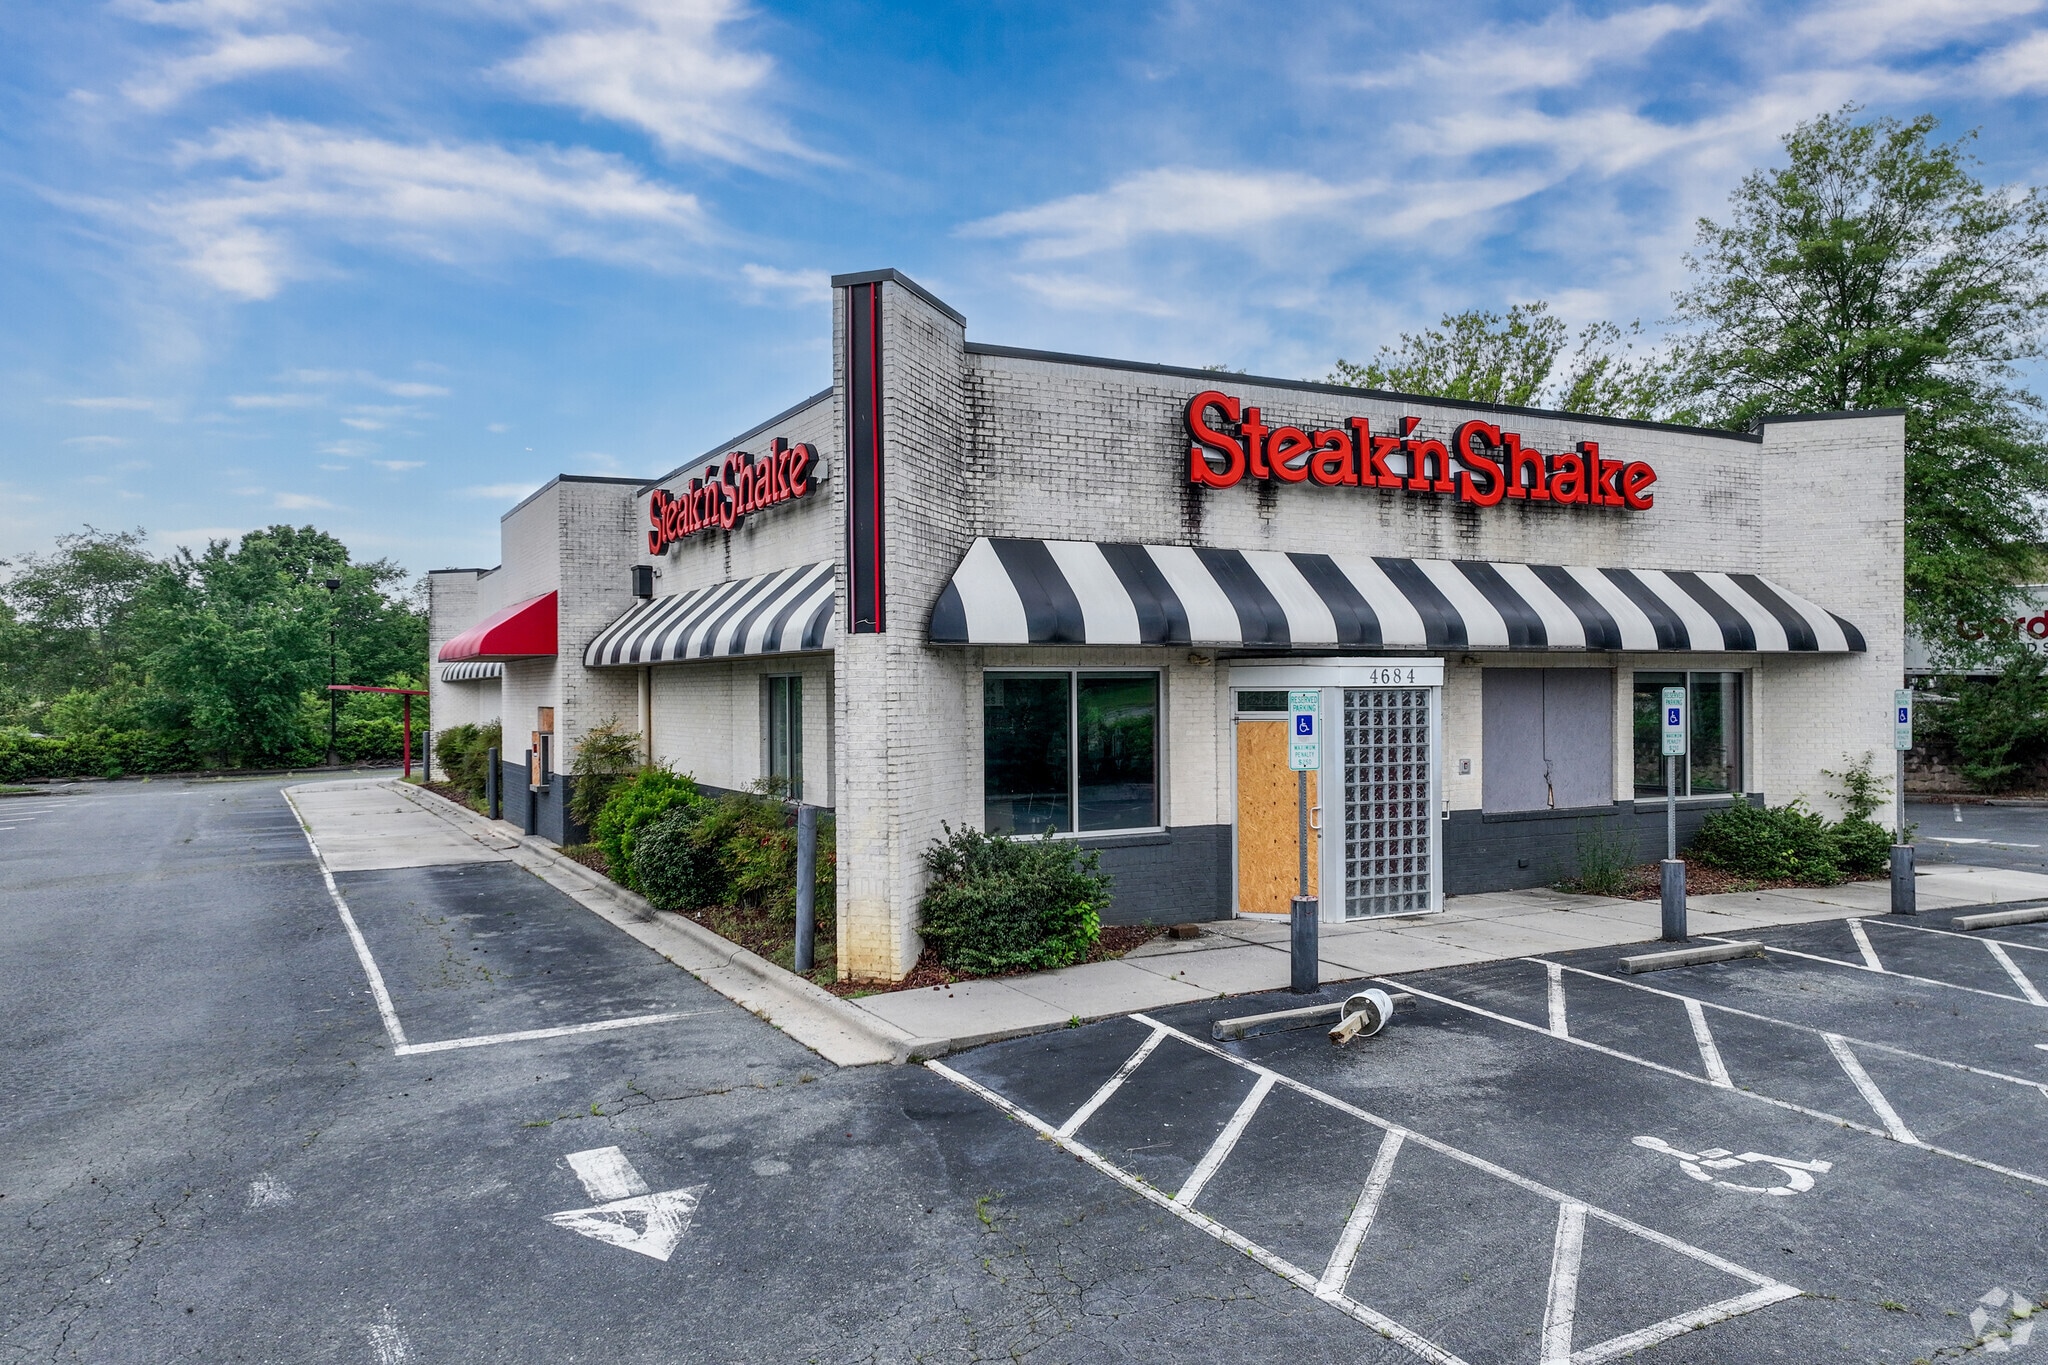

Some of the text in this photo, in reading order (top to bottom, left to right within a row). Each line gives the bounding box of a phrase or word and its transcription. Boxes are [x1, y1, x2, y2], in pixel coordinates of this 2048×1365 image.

[1369, 668, 1415, 684] 4684
[1290, 696, 1318, 704] RESERVED
[1292, 704, 1316, 712] PARKING
